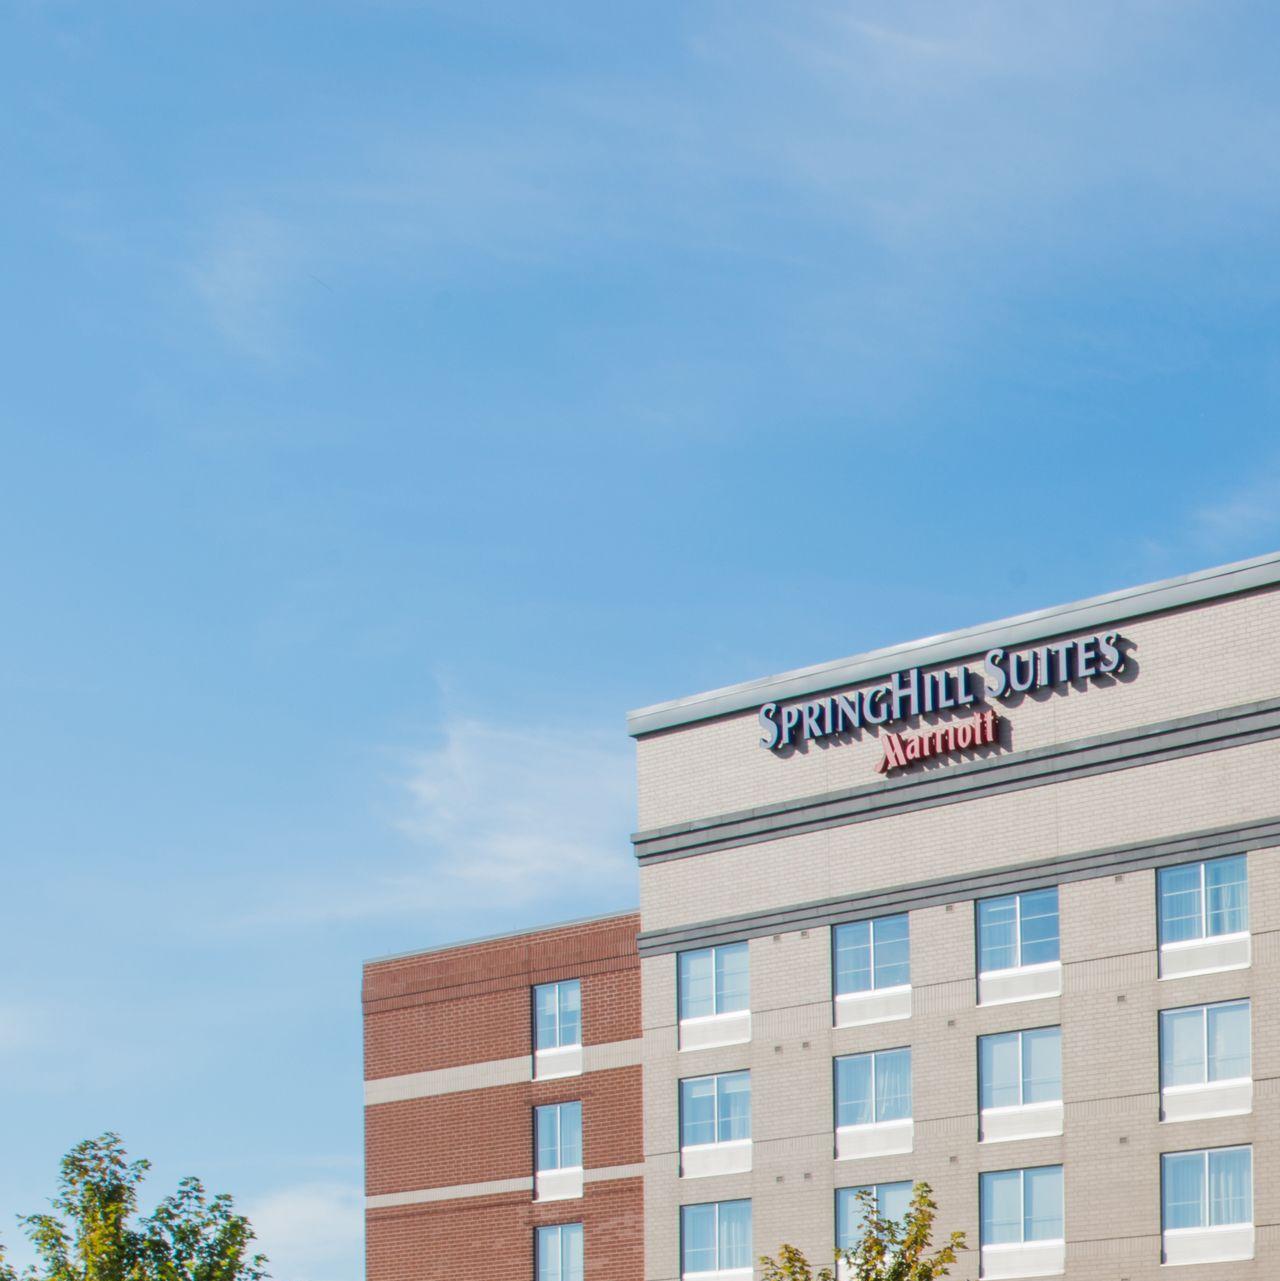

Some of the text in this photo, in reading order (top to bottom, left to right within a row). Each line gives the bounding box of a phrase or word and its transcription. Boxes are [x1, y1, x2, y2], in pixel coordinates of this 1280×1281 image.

[759, 631, 1120, 750] SPRINGHILL SUITES
[874, 709, 996, 774] Marriott
